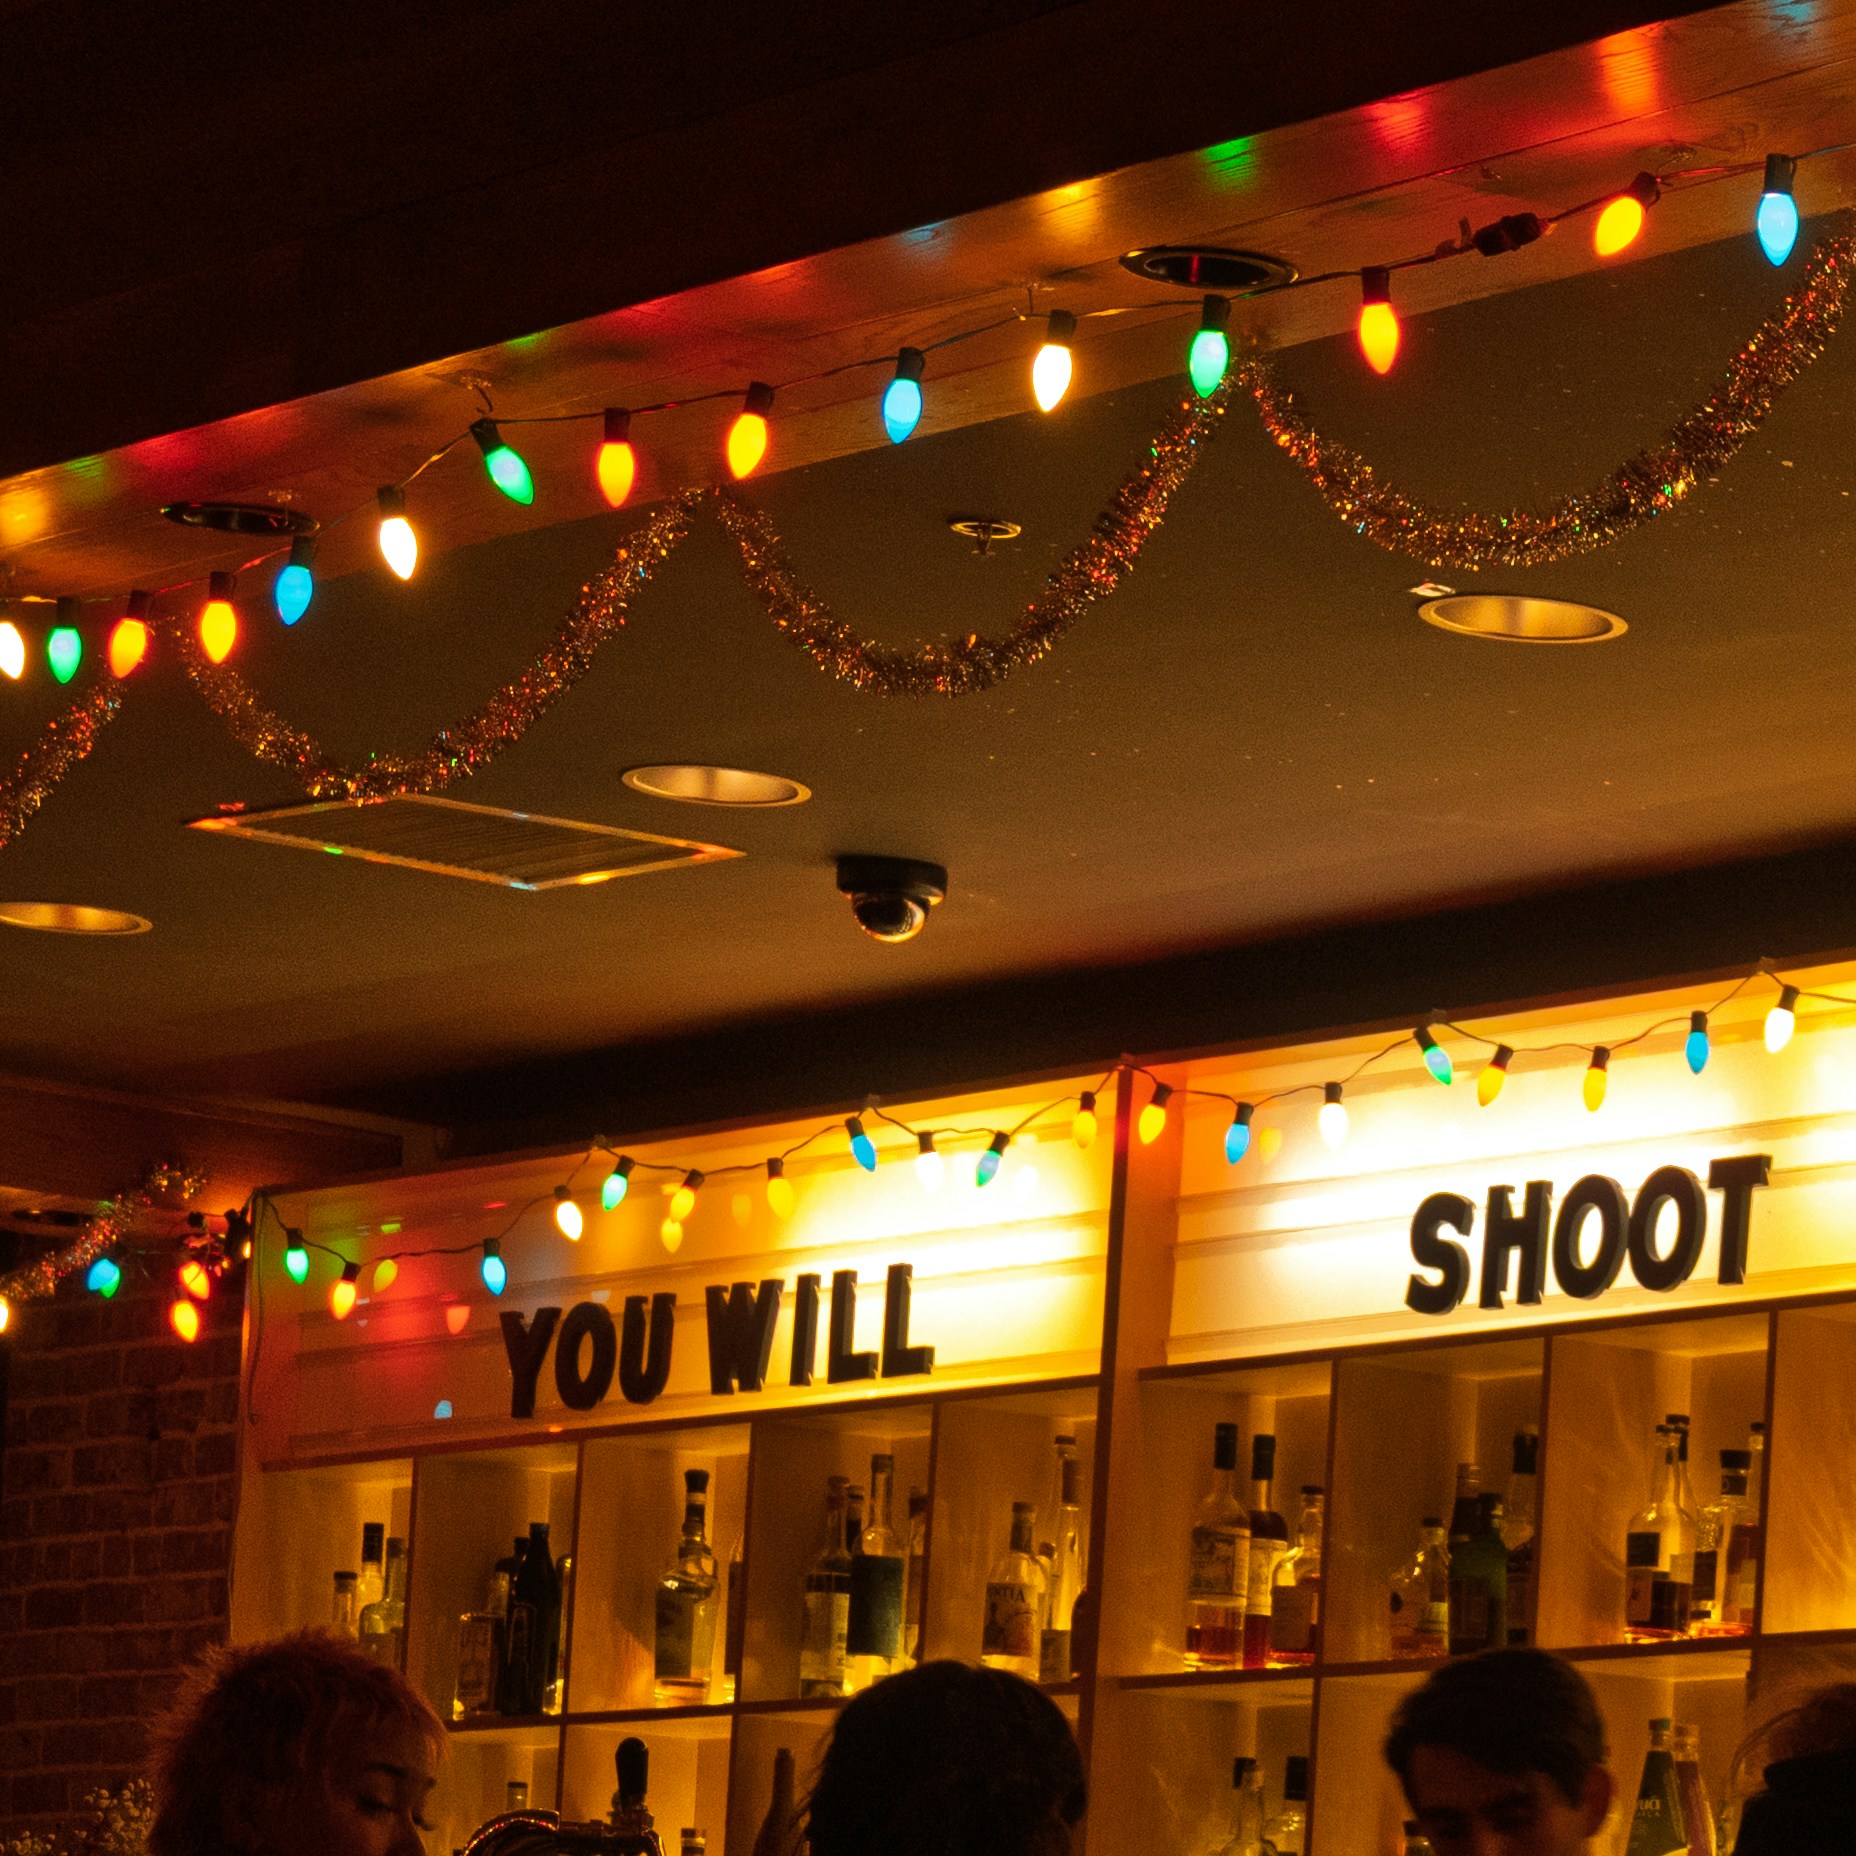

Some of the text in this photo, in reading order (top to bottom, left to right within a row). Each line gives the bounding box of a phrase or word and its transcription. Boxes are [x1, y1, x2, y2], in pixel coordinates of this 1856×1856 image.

[1403, 1153, 1774, 1316] SHOOT
[500, 1262, 936, 1419] YOU WILL
